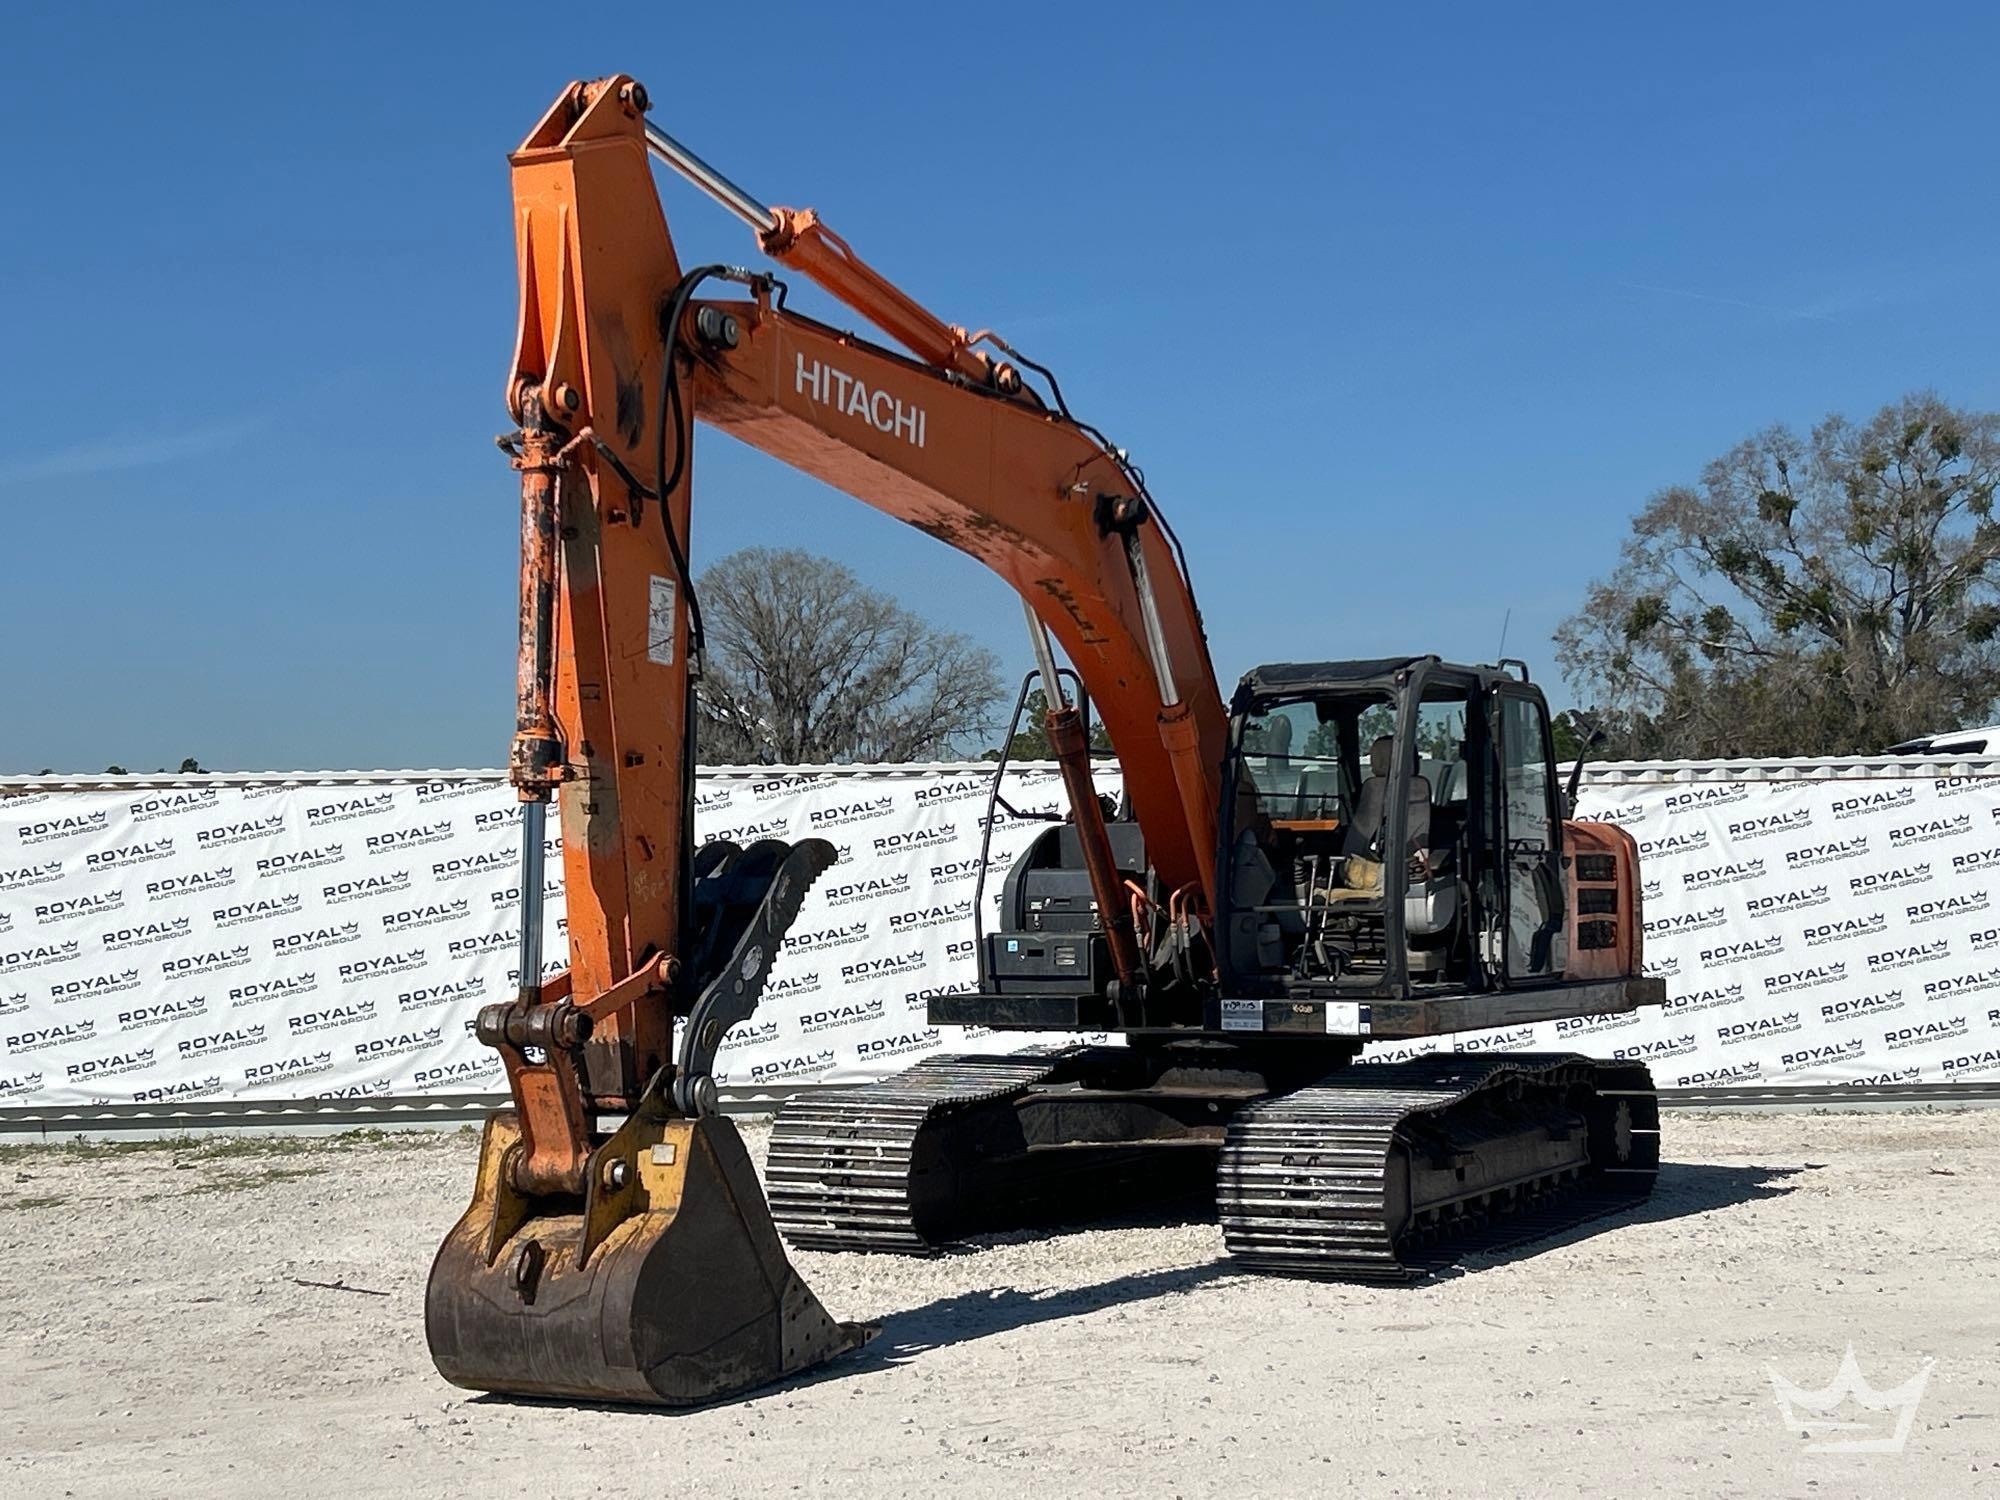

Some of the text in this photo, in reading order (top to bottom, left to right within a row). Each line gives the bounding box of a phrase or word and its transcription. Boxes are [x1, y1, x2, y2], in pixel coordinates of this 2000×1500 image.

[796, 352, 926, 448] HITACHI
[307, 797, 376, 819] ROYAL
[811, 801, 876, 822] ROYAL
[1832, 791, 1897, 812] ROYAL
[1836, 799, 1915, 819] AUCTION GROUP
[19, 815, 89, 837] ROYAL
[310, 805, 394, 826] AUCTION GROUP
[814, 809, 894, 829] AUCTION GROUP
[1729, 813, 1794, 834] ROYAL
[22, 824, 108, 844] AUCTION GROUP
[198, 820, 267, 842] ROYAL
[200, 828, 285, 849] AUCTION GROUP
[367, 825, 435, 847] ROYAL
[874, 828, 940, 849] ROYAL
[1733, 821, 1812, 841] AUCTION GROUP
[1890, 819, 1954, 840] ROYAL
[1893, 826, 1972, 847] AUCTION GROUP
[87, 842, 157, 865] ROYAL
[370, 833, 454, 854] AUCTION GROUP
[877, 836, 957, 856] AUCTION GROUP
[1786, 841, 1851, 862] ROYAL
[90, 851, 175, 872] AUCTION GROUP
[257, 848, 326, 870] ROYAL
[260, 856, 344, 877] AUCTION GROUP
[433, 852, 501, 874] ROYAL
[1790, 849, 1869, 869] AUCTION GROUP
[436, 860, 519, 881] AUCTION GROUP
[1684, 863, 1748, 884] ROYAL
[1687, 871, 1766, 891] AUCTION GROUP
[1850, 867, 1915, 889] ROYAL
[147, 871, 216, 893] ROYAL
[150, 879, 235, 900] AUCTION GROUP
[324, 875, 392, 897] ROYAL
[826, 878, 892, 899] ROYAL
[1854, 875, 1932, 896] AUCTION GROUP
[327, 883, 411, 904] AUCTION GROUP
[829, 886, 910, 906] AUCTION GROUP
[1747, 889, 1812, 911] ROYAL
[36, 894, 106, 916] ROYAL
[39, 902, 124, 924] AUCTION GROUP
[214, 898, 283, 920] ROYAL
[383, 903, 452, 925] ROYAL
[890, 905, 955, 926] ROYAL
[1751, 897, 1830, 918] AUCTION GROUP
[1907, 895, 1972, 916] ROYAL
[1910, 903, 1989, 923] AUCTION GROUP
[217, 906, 301, 928] AUCTION GROUP
[386, 911, 470, 932] AUCTION GROUP
[893, 913, 973, 933] AUCTION GROUP
[103, 921, 173, 944] ROYAL
[273, 926, 342, 949] ROYAL
[1804, 918, 1869, 939] ROYAL
[1808, 925, 1887, 946] AUCTION GROUP
[106, 930, 191, 951] AUCTION GROUP
[276, 934, 360, 956] AUCTION GROUP
[1701, 940, 1766, 961] ROYAL
[163, 950, 232, 972] ROYAL
[340, 953, 409, 976] ROYAL
[1704, 948, 1784, 968] AUCTION GROUP
[1868, 944, 1932, 965] ROYAL
[1871, 952, 1950, 972] AUCTION GROUP
[166, 958, 251, 980] AUCTION GROUP
[343, 961, 427, 983] AUCTION GROUP
[842, 955, 908, 976] ROYAL
[845, 963, 926, 983] AUCTION GROUP
[52, 973, 122, 996] ROYAL
[1765, 966, 1830, 988] ROYAL
[1768, 974, 1847, 994] AUCTION GROUP
[55, 982, 140, 1003] AUCTION GROUP
[230, 977, 299, 999] ROYAL
[233, 985, 317, 1006] AUCTION GROUP
[399, 982, 468, 1004] ROYAL
[402, 989, 485, 1011] AUCTION GROUP
[1822, 994, 1887, 1016] ROYAL
[119, 1000, 189, 1023] ROYAL
[122, 1009, 207, 1030] AUCTION GROUP
[289, 1005, 358, 1028] ROYAL
[800, 1004, 867, 1026] ROYAL
[1825, 1002, 1904, 1023] AUCTION GROUP
[292, 1013, 376, 1035] AUCTION GROUP
[803, 1012, 884, 1033] AUCTION GROUP
[1718, 1016, 1784, 1038] ROYAL
[1885, 1021, 1950, 1042] ROYAL
[7, 1024, 78, 1047] ROYAL
[10, 1032, 96, 1054] AUCTION GROUP
[179, 1029, 248, 1052] ROYAL
[356, 1032, 424, 1054] ROYAL
[858, 1033, 924, 1054] ROYAL
[1722, 1024, 1801, 1045] AUCTION GROUP
[1889, 1029, 1968, 1049] AUCTION GROUP
[182, 1037, 267, 1059] AUCTION GROUP
[359, 1040, 443, 1062] AUCTION GROUP
[1782, 1043, 1847, 1065] ROYAL
[67, 1053, 137, 1076] ROYAL
[70, 1061, 156, 1083] AUCTION GROUP
[245, 1056, 315, 1079] ROYAL
[415, 1060, 483, 1082] ROYAL
[752, 1055, 818, 1076] ROYAL
[1786, 1051, 1865, 1072] AUCTION GROUP
[248, 1064, 333, 1086] AUCTION GROUP
[418, 1068, 501, 1089] AUCTION GROUP
